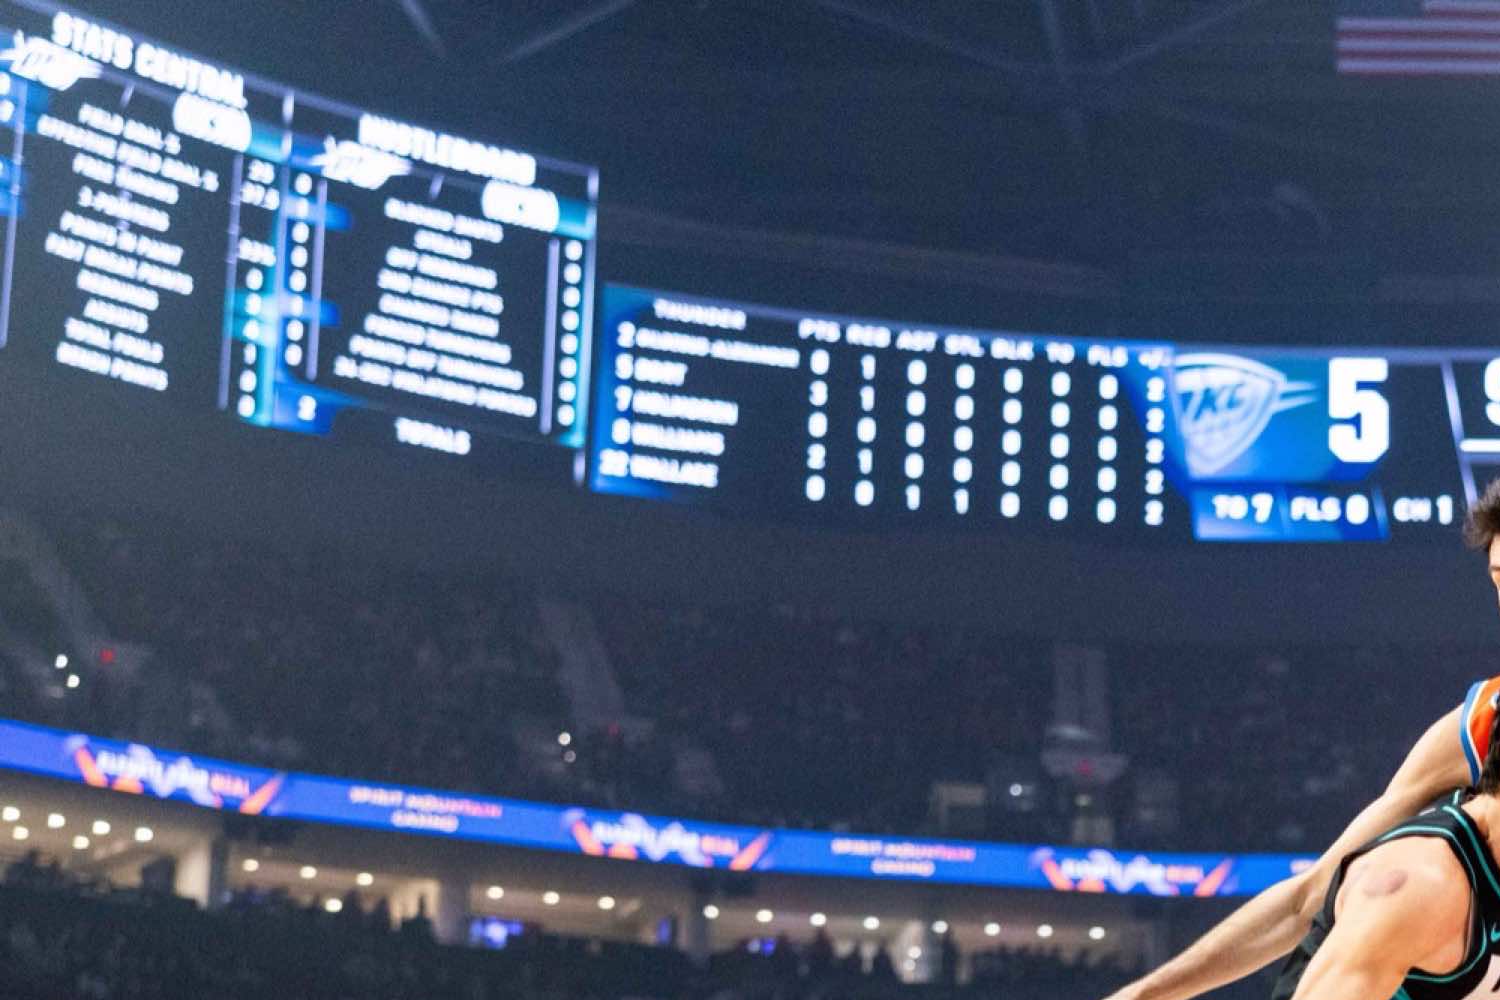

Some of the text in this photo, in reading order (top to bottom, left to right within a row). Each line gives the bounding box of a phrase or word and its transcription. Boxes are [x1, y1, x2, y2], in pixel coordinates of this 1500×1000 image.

[1329, 357, 1389, 463] 5
[1252, 494, 1273, 522] 7
[1437, 495, 1453, 524] 1
